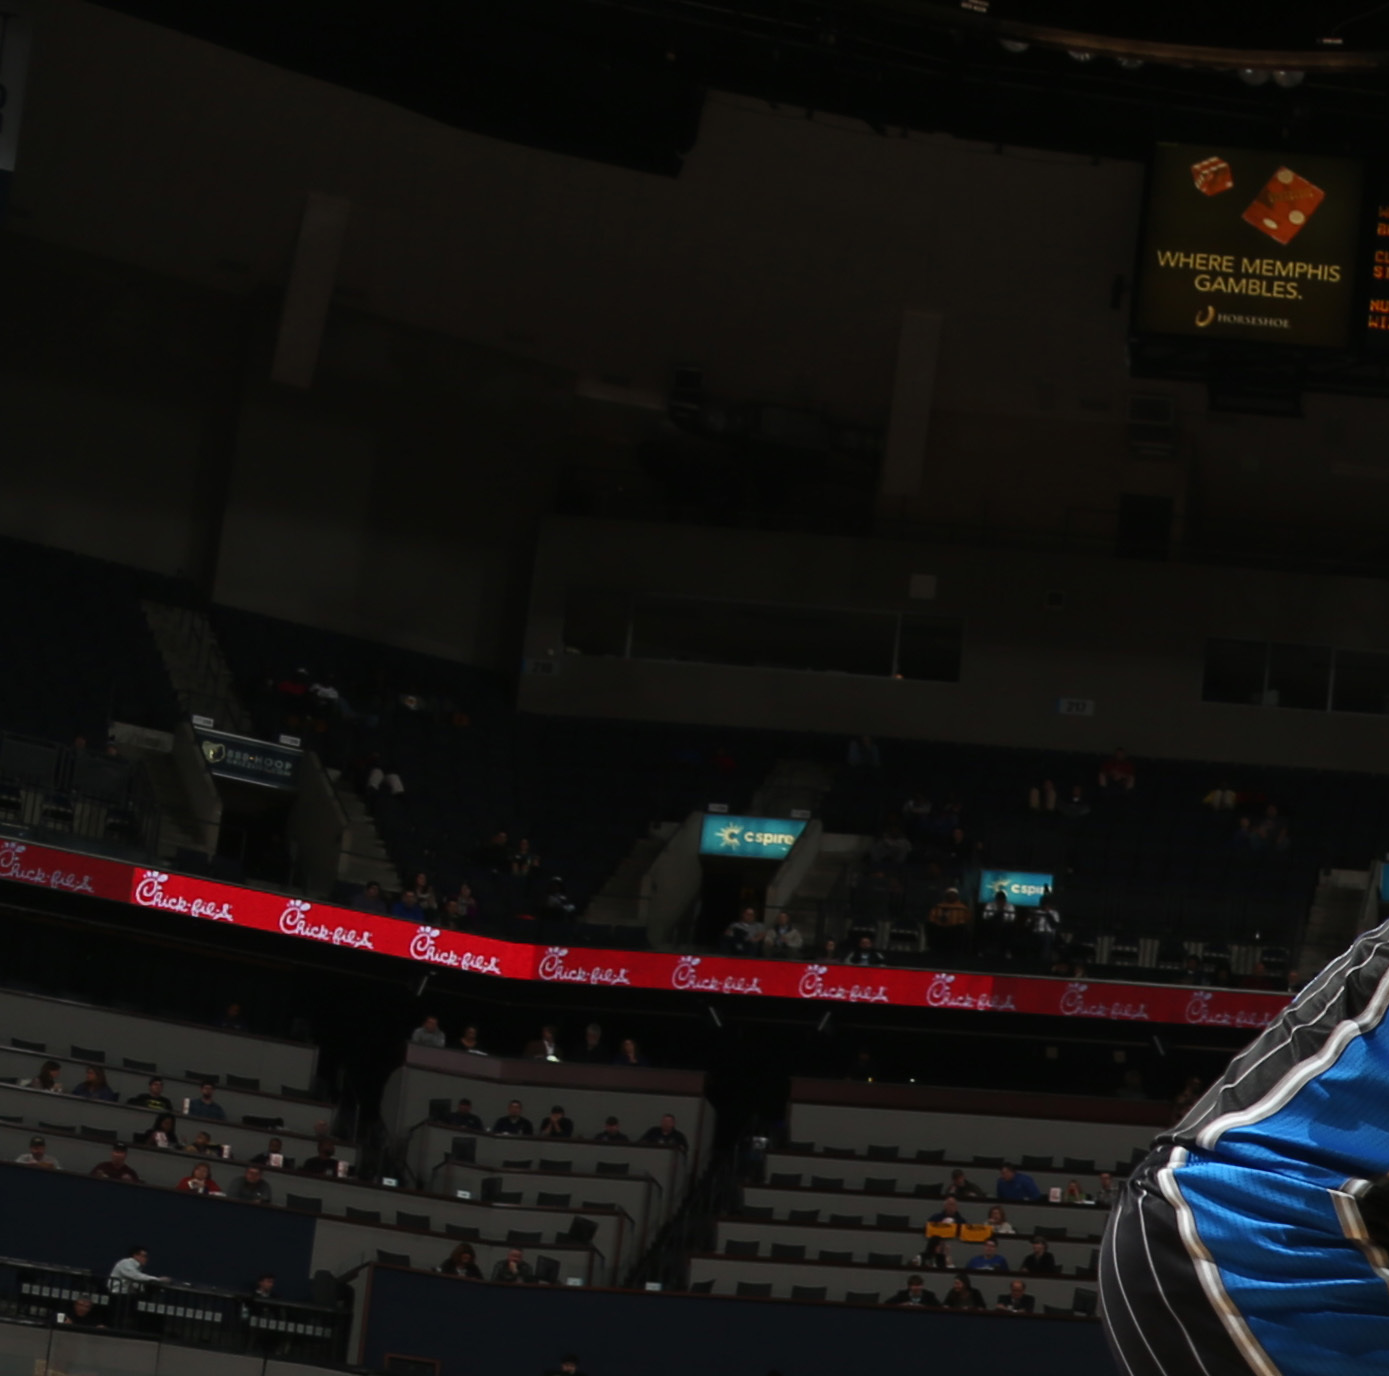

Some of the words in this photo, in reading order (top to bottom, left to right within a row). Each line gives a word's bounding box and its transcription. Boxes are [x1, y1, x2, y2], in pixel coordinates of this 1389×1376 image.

[1156, 250, 1236, 274] WHERE
[1241, 257, 1342, 283] MEMPHIS
[1194, 275, 1303, 300] GAMBLES.
[1217, 313, 1290, 329] HORSESHOE
